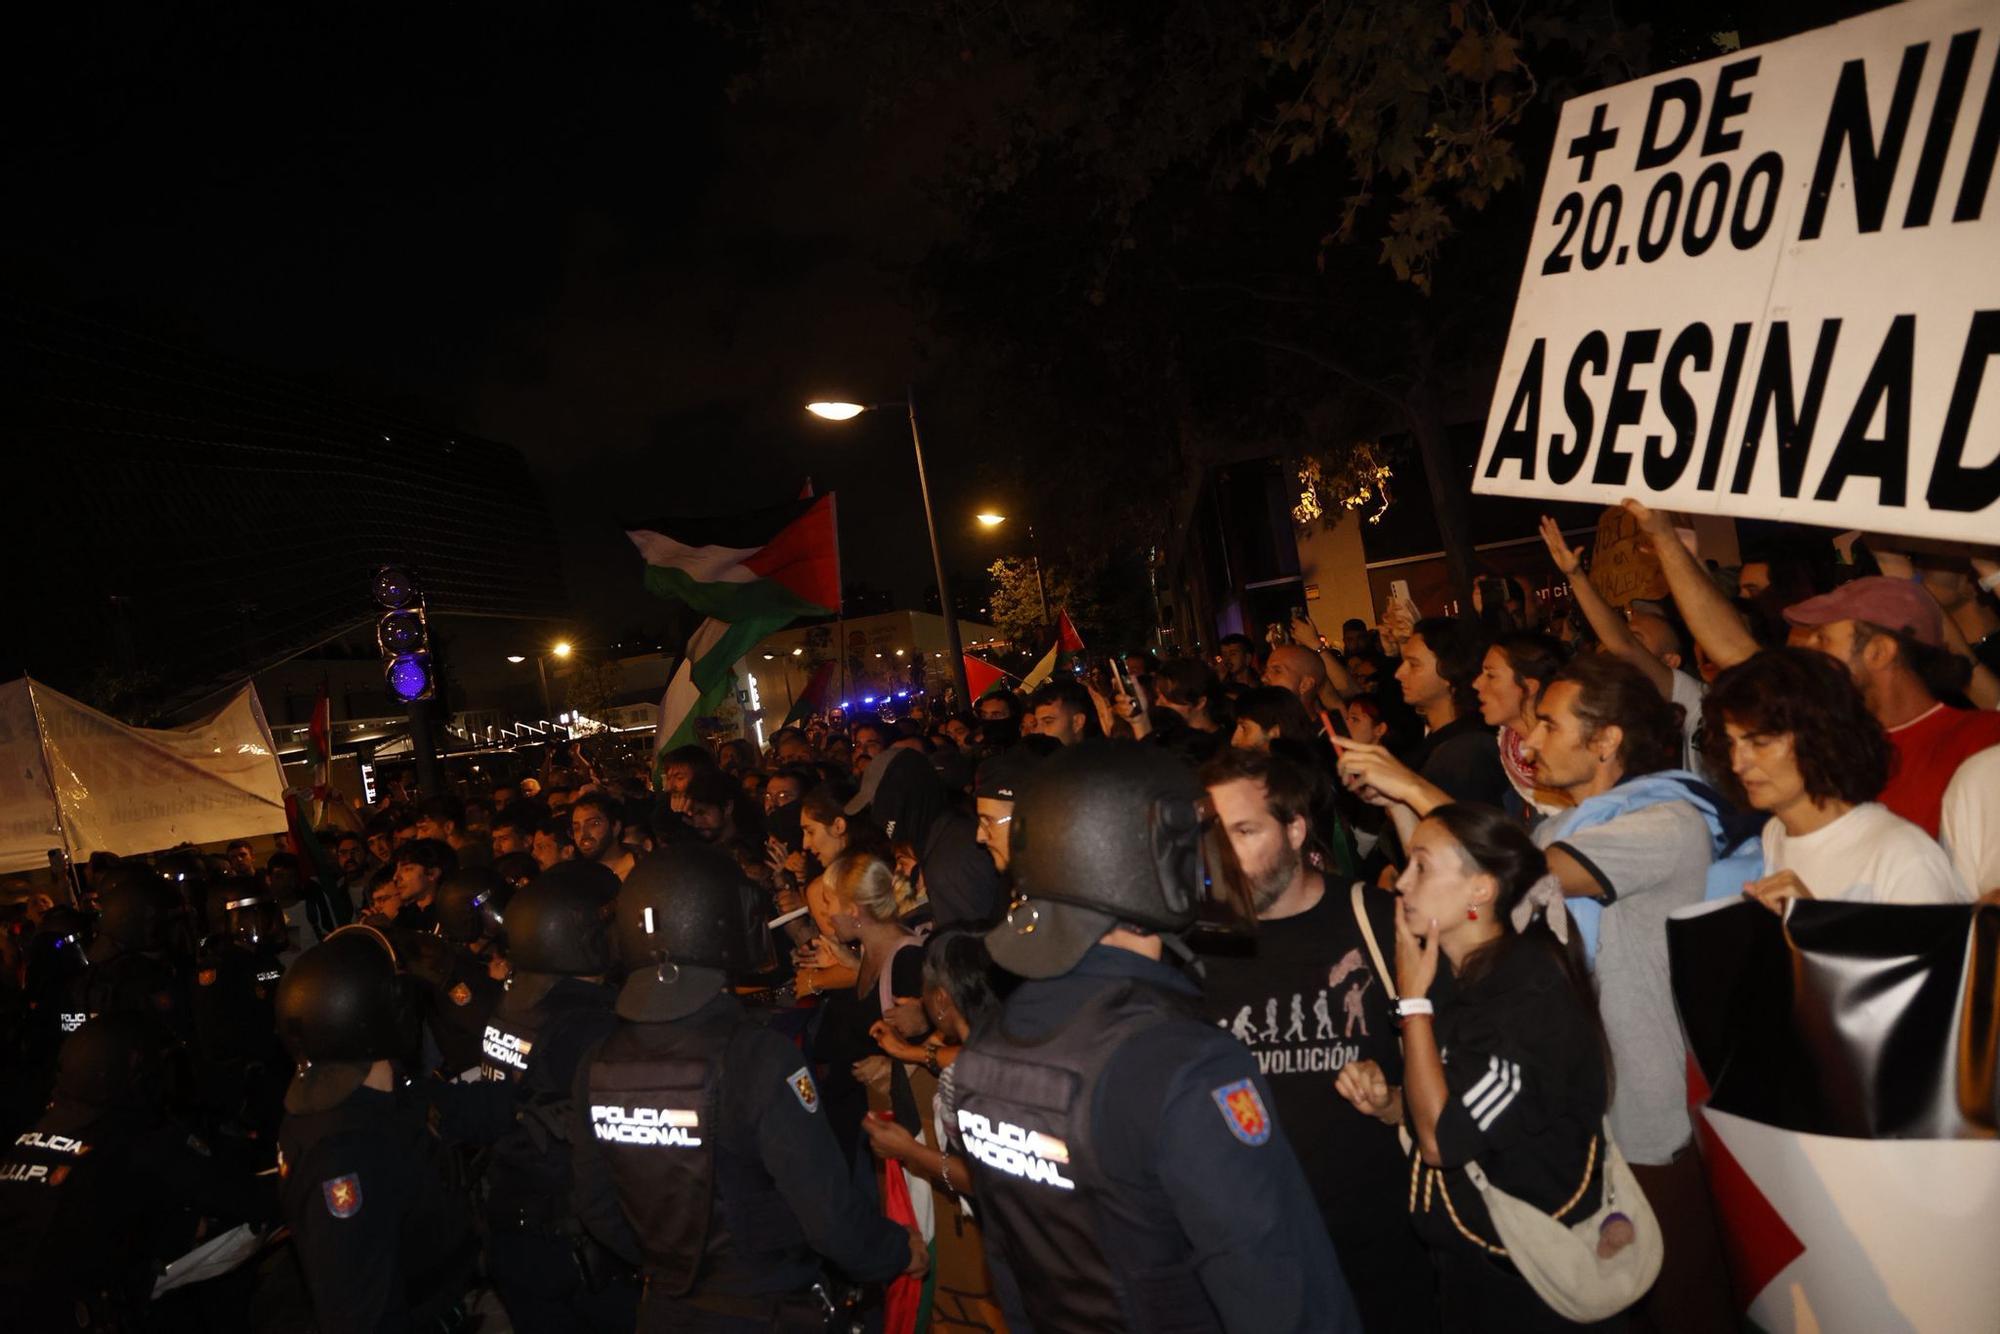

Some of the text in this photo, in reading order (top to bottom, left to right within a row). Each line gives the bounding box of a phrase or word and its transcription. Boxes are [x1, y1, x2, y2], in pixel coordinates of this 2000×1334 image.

[1635, 56, 1762, 170] DE
[1541, 151, 1784, 275] 20.000
[484, 1025, 521, 1051] POLICIA
[482, 1039, 529, 1070] NACIONAL
[591, 1105, 674, 1127] POLICIA
[15, 1132, 82, 1153] POLICIA
[594, 1122, 702, 1146] NACIONAL
[957, 1109, 1042, 1157] POLICIA
[962, 1133, 1075, 1190] NACIONAL
